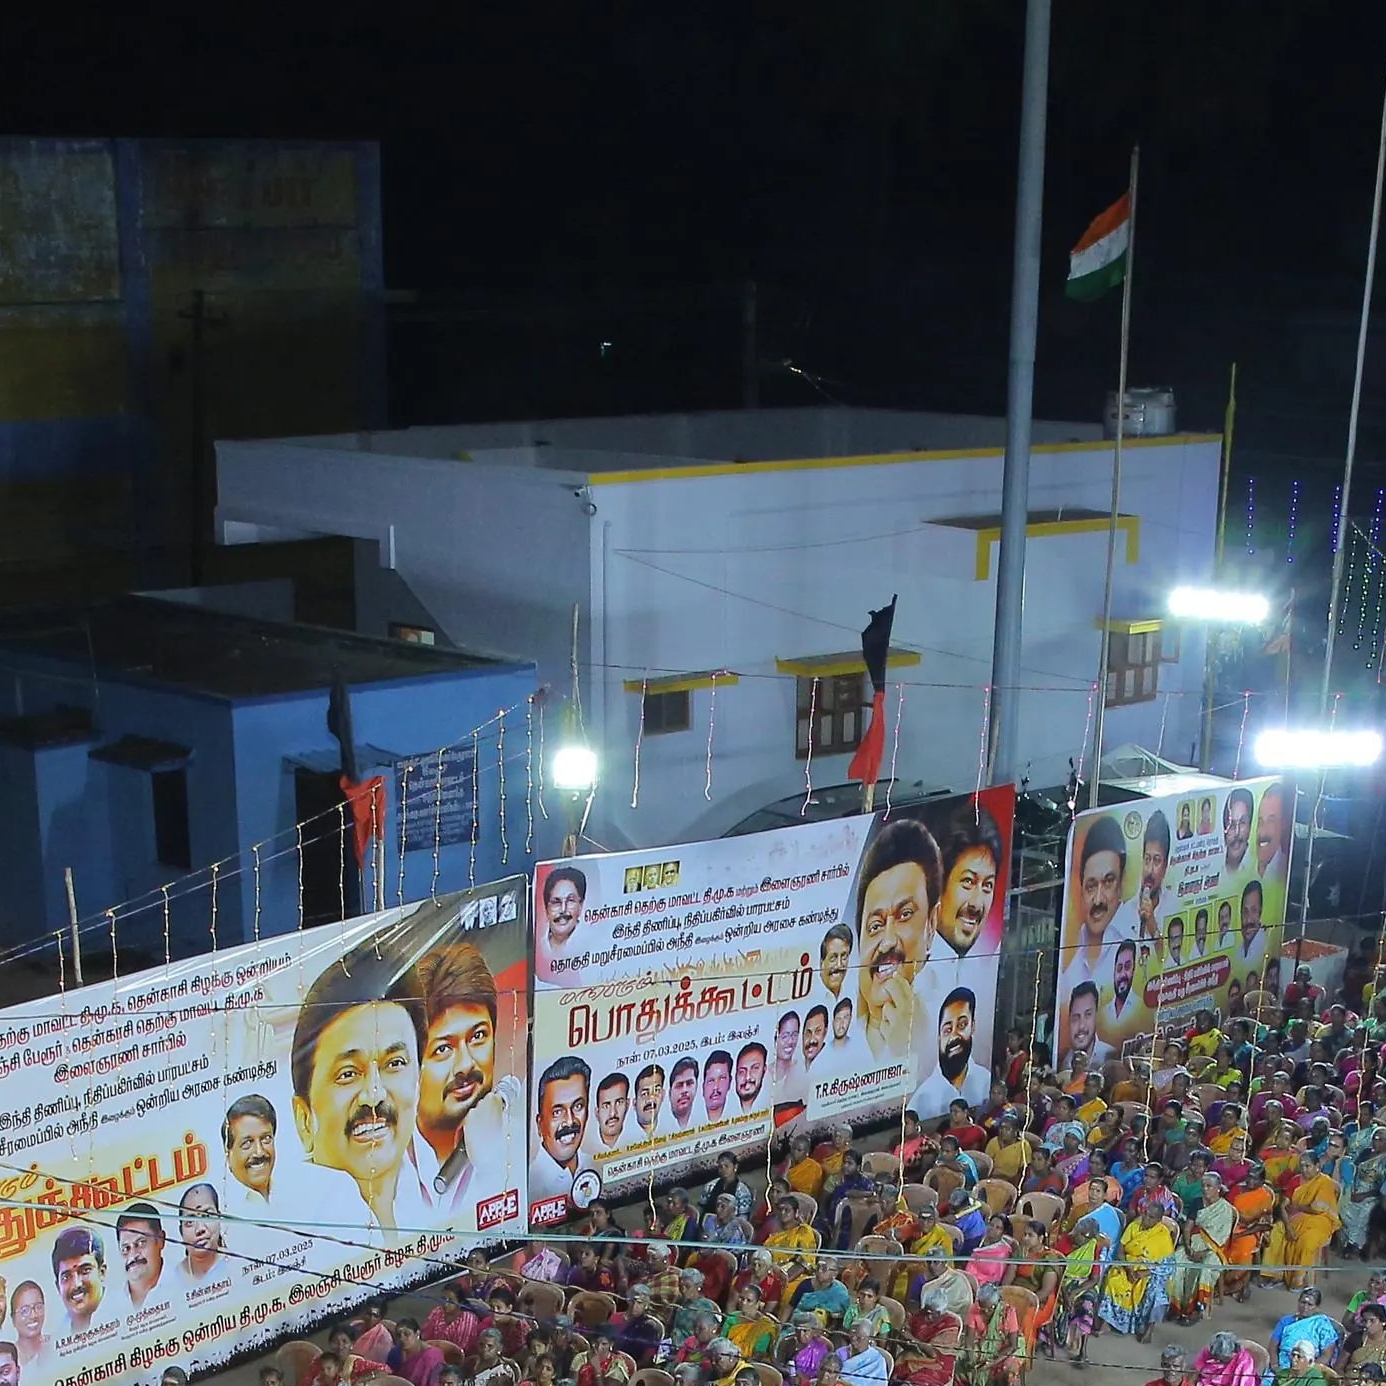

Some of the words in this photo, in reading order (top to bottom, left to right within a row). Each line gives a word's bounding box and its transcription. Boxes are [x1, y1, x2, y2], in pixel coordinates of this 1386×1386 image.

[584, 900, 633, 926] தென்காசி
[634, 897, 667, 918] தெற்கு
[668, 890, 702, 911] மாவட்ட
[703, 882, 734, 906] தி.மு.க
[760, 867, 821, 894] இளைஞரணி
[820, 861, 851, 884] சார்பில்
[612, 920, 641, 941] இந்தி
[683, 904, 746, 931] நிதிப்பகிர்வில்
[746, 895, 790, 918] பாரபட்சம்
[550, 954, 590, 974] தொகுதி
[591, 936, 666, 966] மறுசீரமைப்பில்
[666, 930, 695, 951] அநீதி
[725, 921, 762, 944] ஒன்றிய
[763, 916, 797, 934] அரசை
[798, 905, 840, 928] கண்டித்து
[32, 1013, 78, 1038] மாவட்ட
[127, 978, 189, 1014] தென்காசி
[190, 966, 234, 997] கிழக்கு
[235, 951, 292, 987] ஒன்றியம்
[568, 952, 814, 1049] பொதுக்கூட்டம்
[23, 1040, 63, 1069] பேரூர்
[72, 1018, 134, 1054] தென்காசி
[136, 1011, 177, 1036] தெற்கு
[224, 986, 264, 1013] தி.மு.க
[54, 1043, 140, 1084] இளைஞரணி
[141, 1029, 188, 1057] சார்பில்
[616, 1053, 641, 1068] நாள்:
[643, 1038, 698, 1061] 07.03.2025,
[700, 1032, 726, 1047] இடம்:
[727, 1024, 760, 1042] இலஞ்சி
[66, 1110, 99, 1138] அநீதி
[135, 1089, 181, 1120] ஒன்றிய
[181, 1078, 222, 1101] அரசை
[222, 1059, 278, 1088] கண்டித்து
[83, 1069, 157, 1111] நிதிப்பகிர்வில்
[158, 1053, 210, 1084] பாரபட்சம்
[607, 1157, 645, 1177] தென்காசி
[717, 1124, 765, 1146] இளைஞரணி
[478, 1195, 517, 1226] APPLE
[531, 1199, 566, 1225] APPLE
[264, 1238, 314, 1264] 07.03.2025
[129, 1337, 181, 1370] கிழக்கு
[181, 1313, 238, 1353] ஒன்றிய
[288, 1267, 342, 1306] இலஞ்சி
[342, 1253, 383, 1283] பேரூர்
